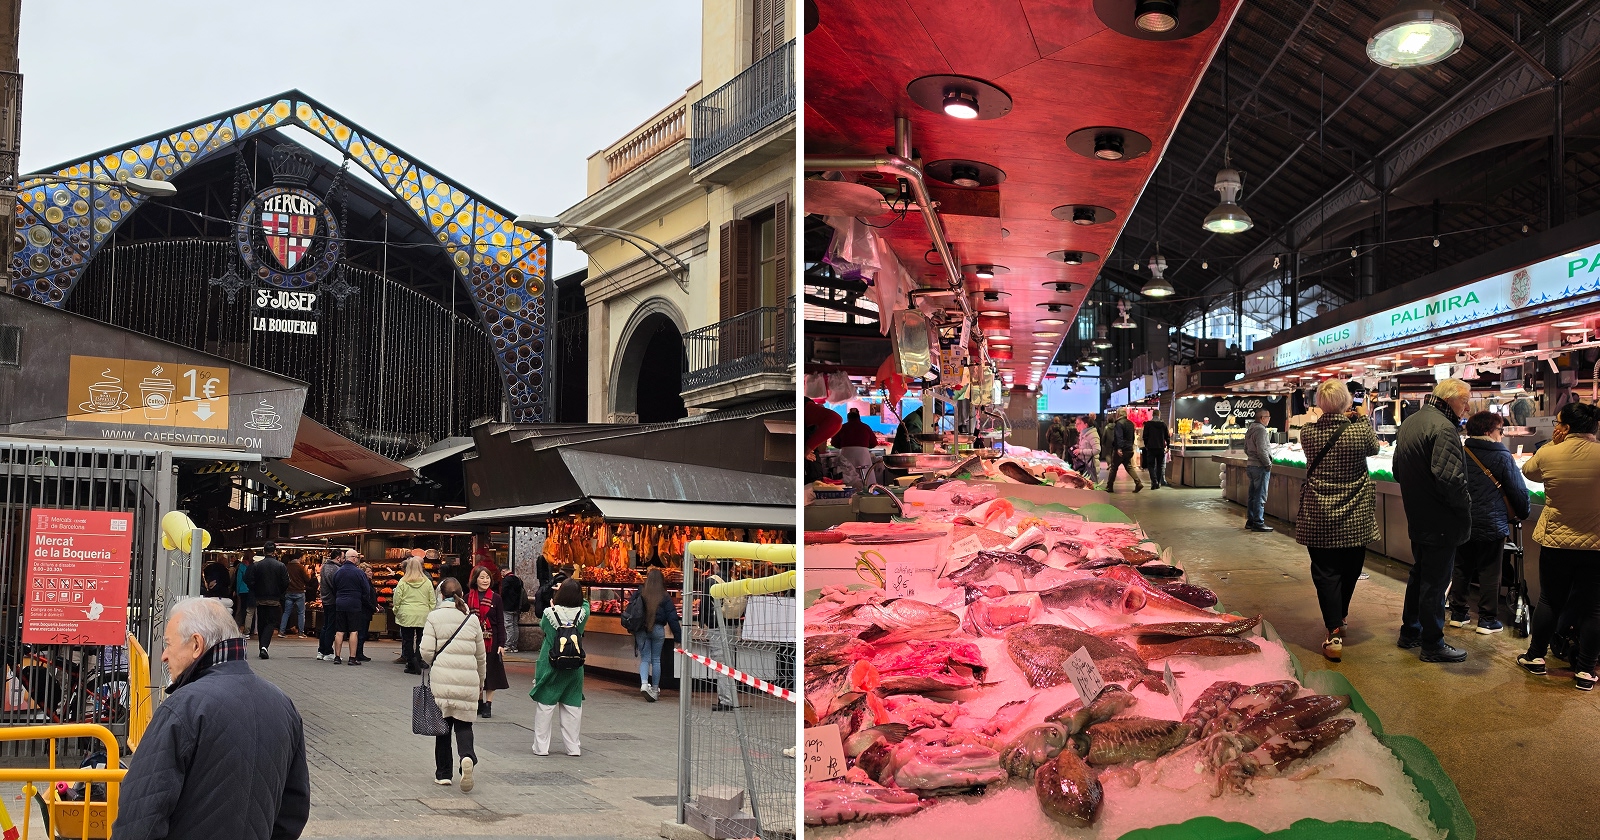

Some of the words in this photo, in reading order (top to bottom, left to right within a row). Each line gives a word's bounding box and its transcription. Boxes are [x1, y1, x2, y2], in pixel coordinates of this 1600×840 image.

[264, 194, 316, 215] MERCAT
[270, 290, 317, 312] JOSEP
[1391, 291, 1480, 326] PALMIRA
[253, 317, 266, 332] LA
[268, 318, 318, 335] BOQUERIA
[1317, 328, 1351, 347] NEUS
[235, 436, 262, 449] COM
[381, 511, 426, 523] VIDAL
[35, 535, 74, 547] Mercat
[34, 546, 49, 557] de
[50, 547, 60, 558] la
[62, 547, 111, 560] Boqueria
[62, 809, 80, 817] NO
